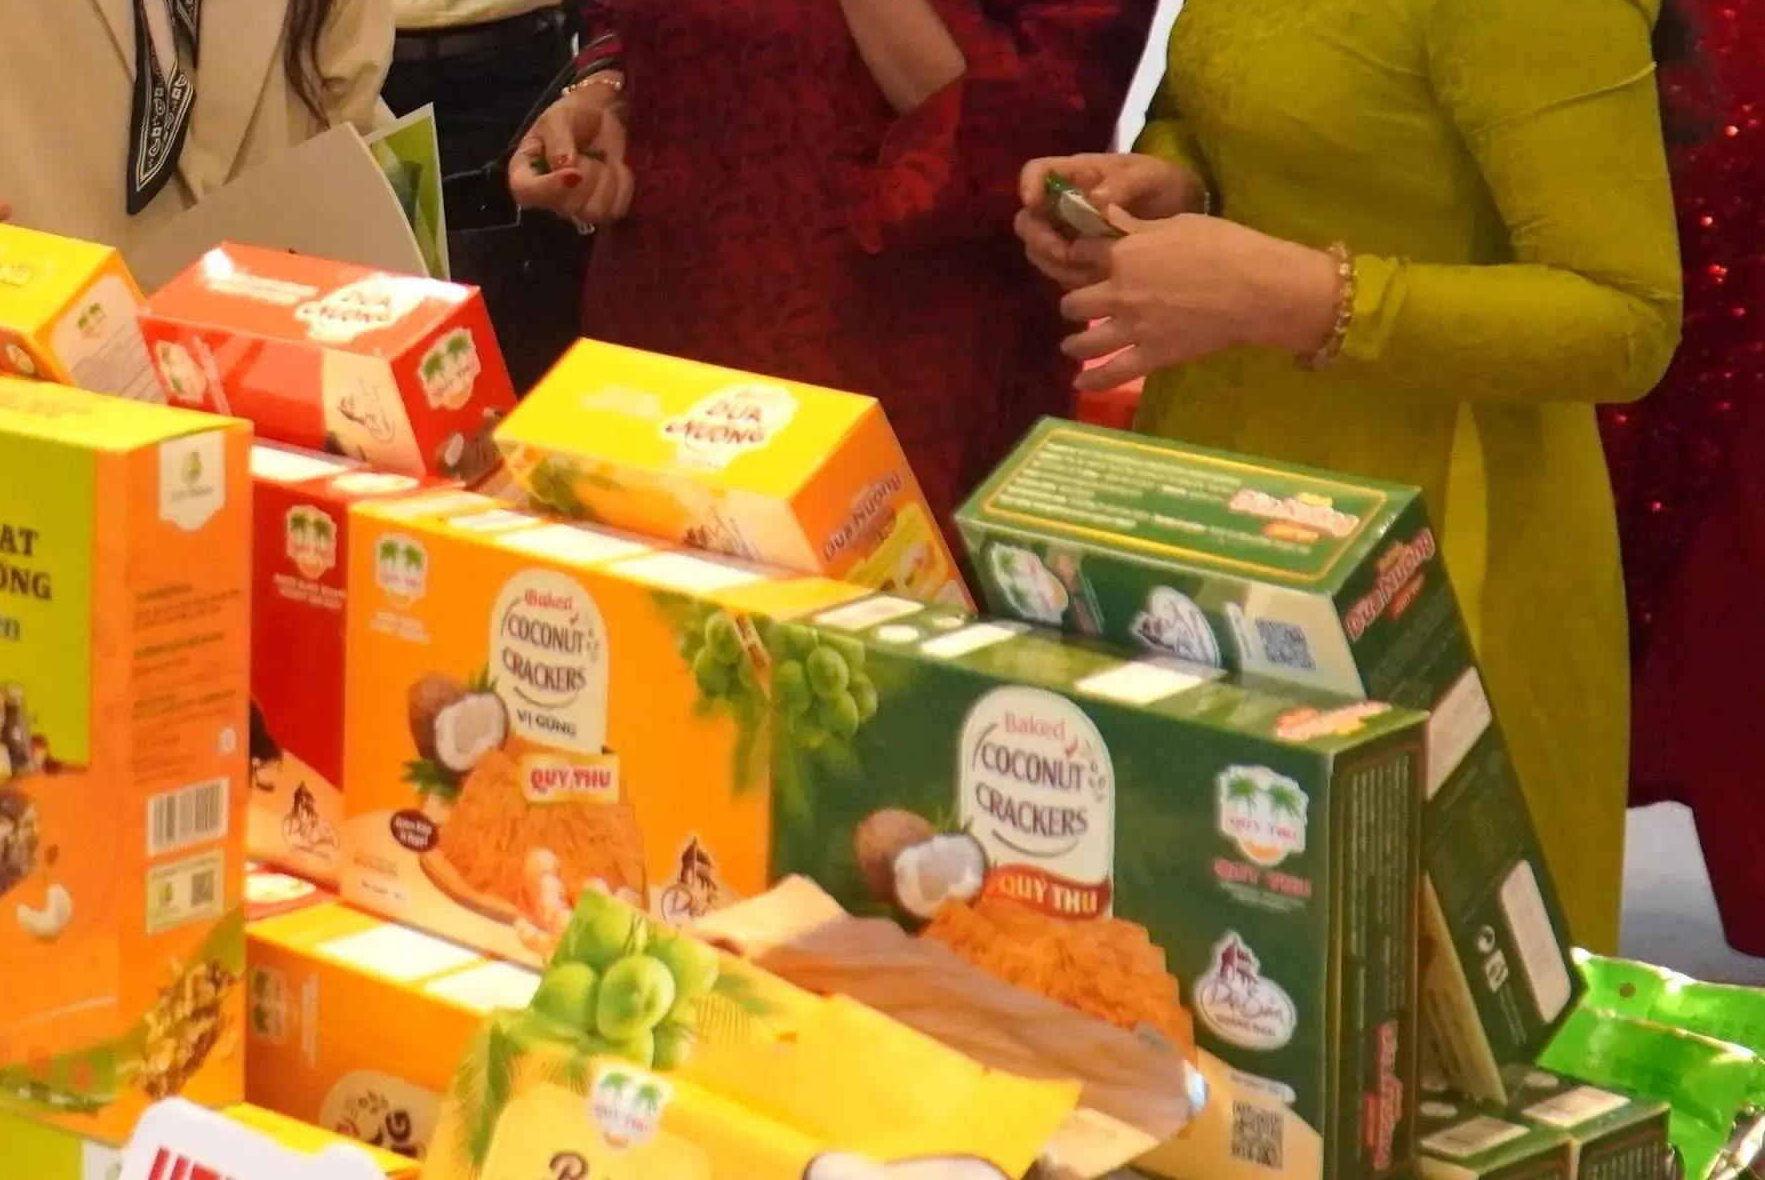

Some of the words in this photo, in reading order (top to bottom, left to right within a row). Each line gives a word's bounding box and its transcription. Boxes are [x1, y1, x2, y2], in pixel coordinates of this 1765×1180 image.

[507, 613, 586, 655] COCONUT
[501, 645, 587, 693] CRACKERS
[1004, 710, 1066, 740] Baked
[571, 767, 612, 790] THU
[980, 740, 1087, 791] COCONUT
[975, 780, 1090, 837] CRACKERS
[1051, 883, 1099, 915] THU
